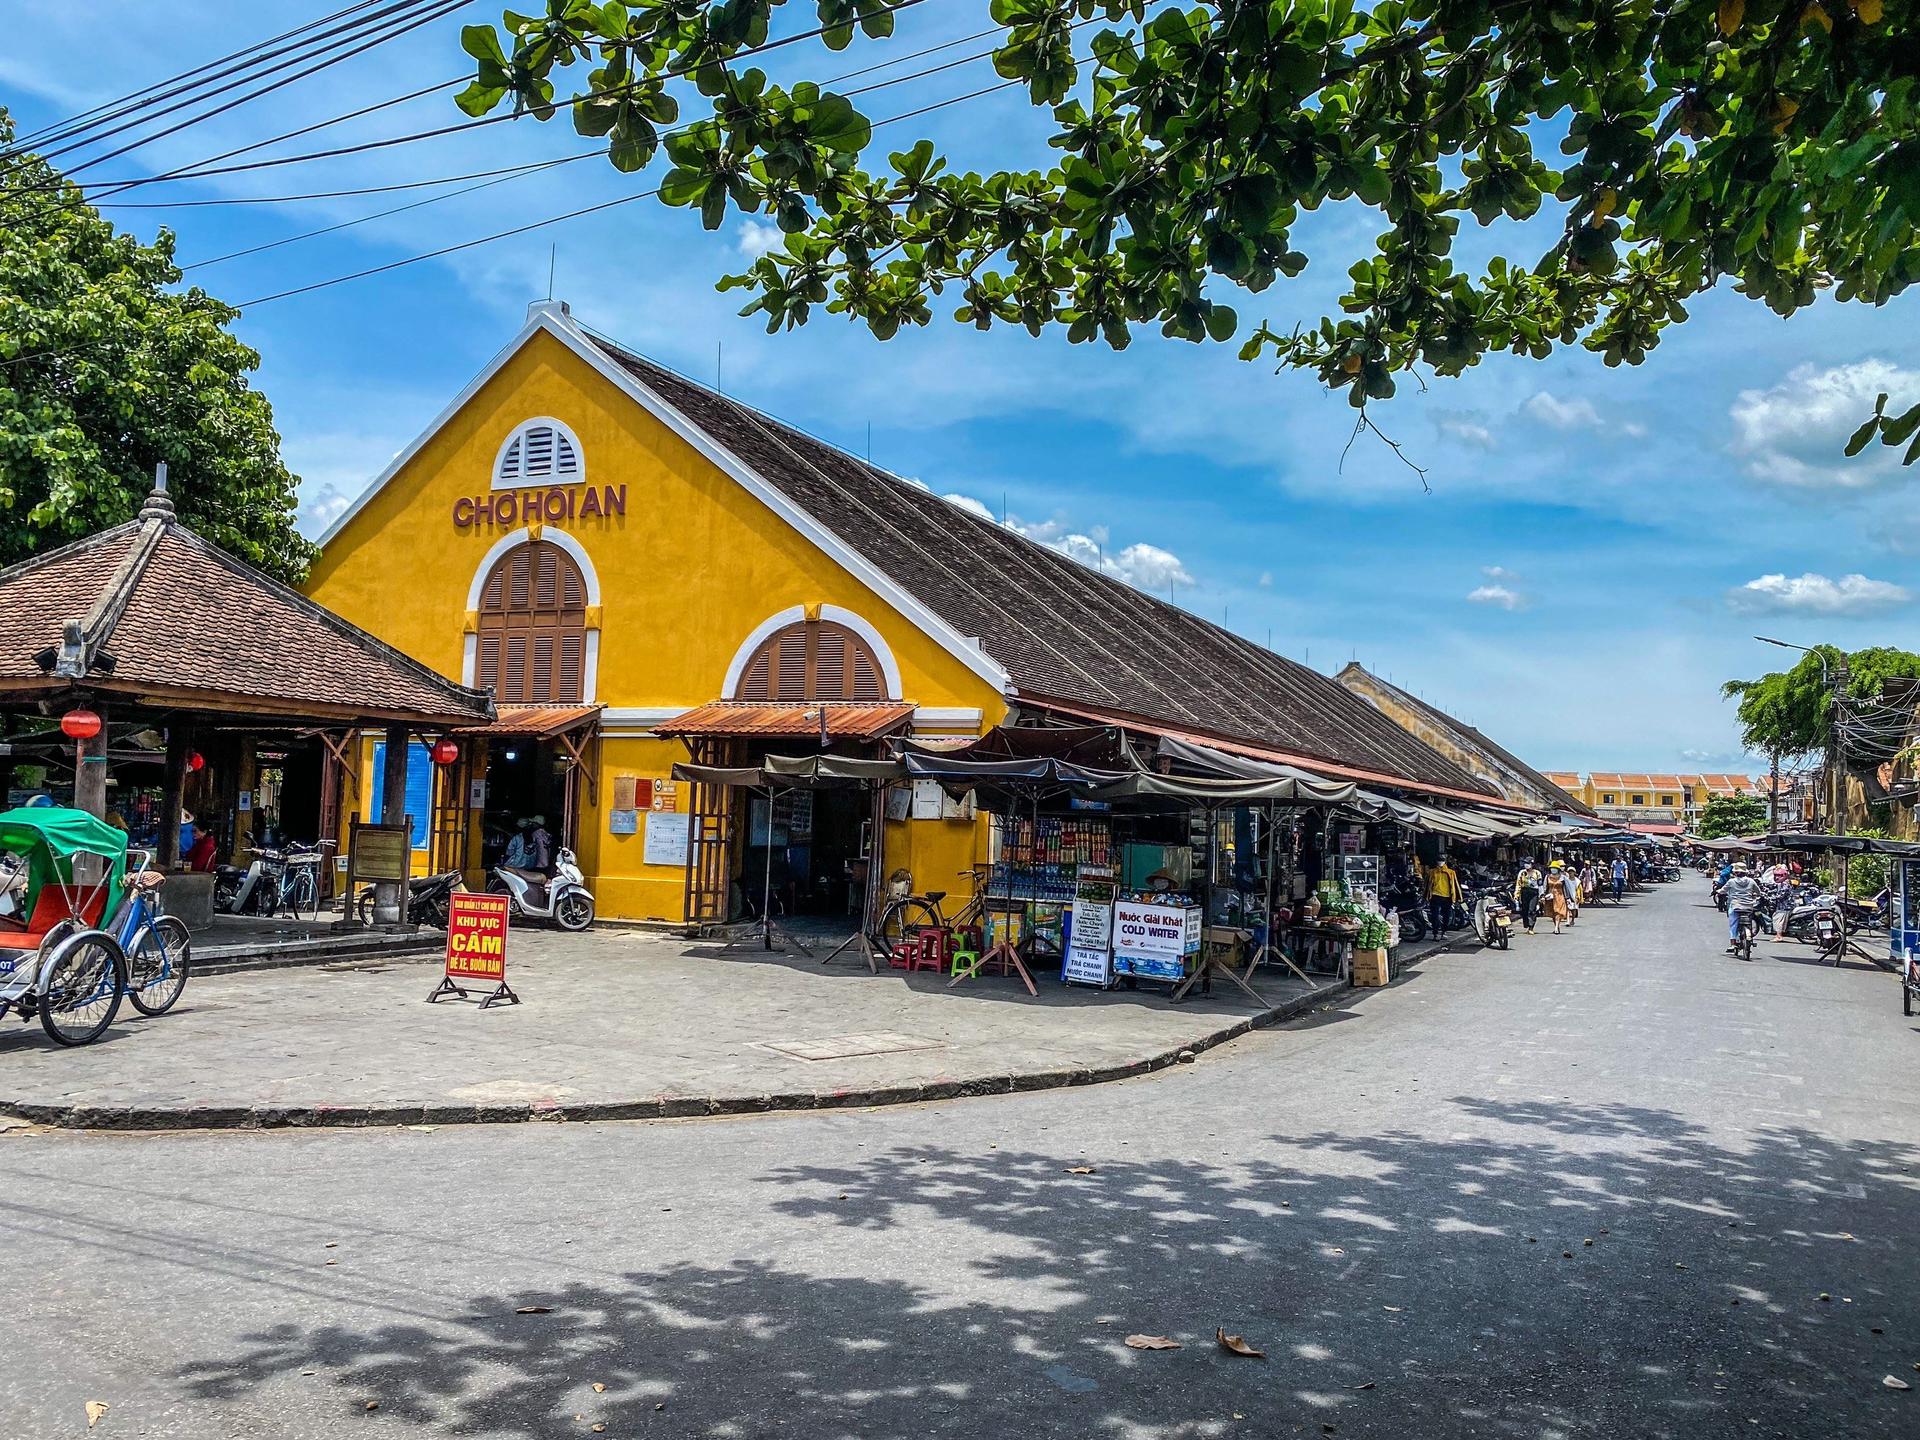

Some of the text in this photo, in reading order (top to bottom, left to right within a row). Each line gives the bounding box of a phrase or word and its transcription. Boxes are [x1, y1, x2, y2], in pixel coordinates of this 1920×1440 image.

[522, 485, 576, 527] HỘI
[579, 484, 626, 518] AN
[456, 916, 500, 930] KHU VỰC
[1119, 911, 1141, 922] Nước
[1143, 914, 1160, 925] Giải
[1162, 915, 1183, 927] Khát
[1122, 924, 1145, 935] COLD
[1148, 927, 1179, 939] WATER
[452, 929, 502, 954] CẤM
